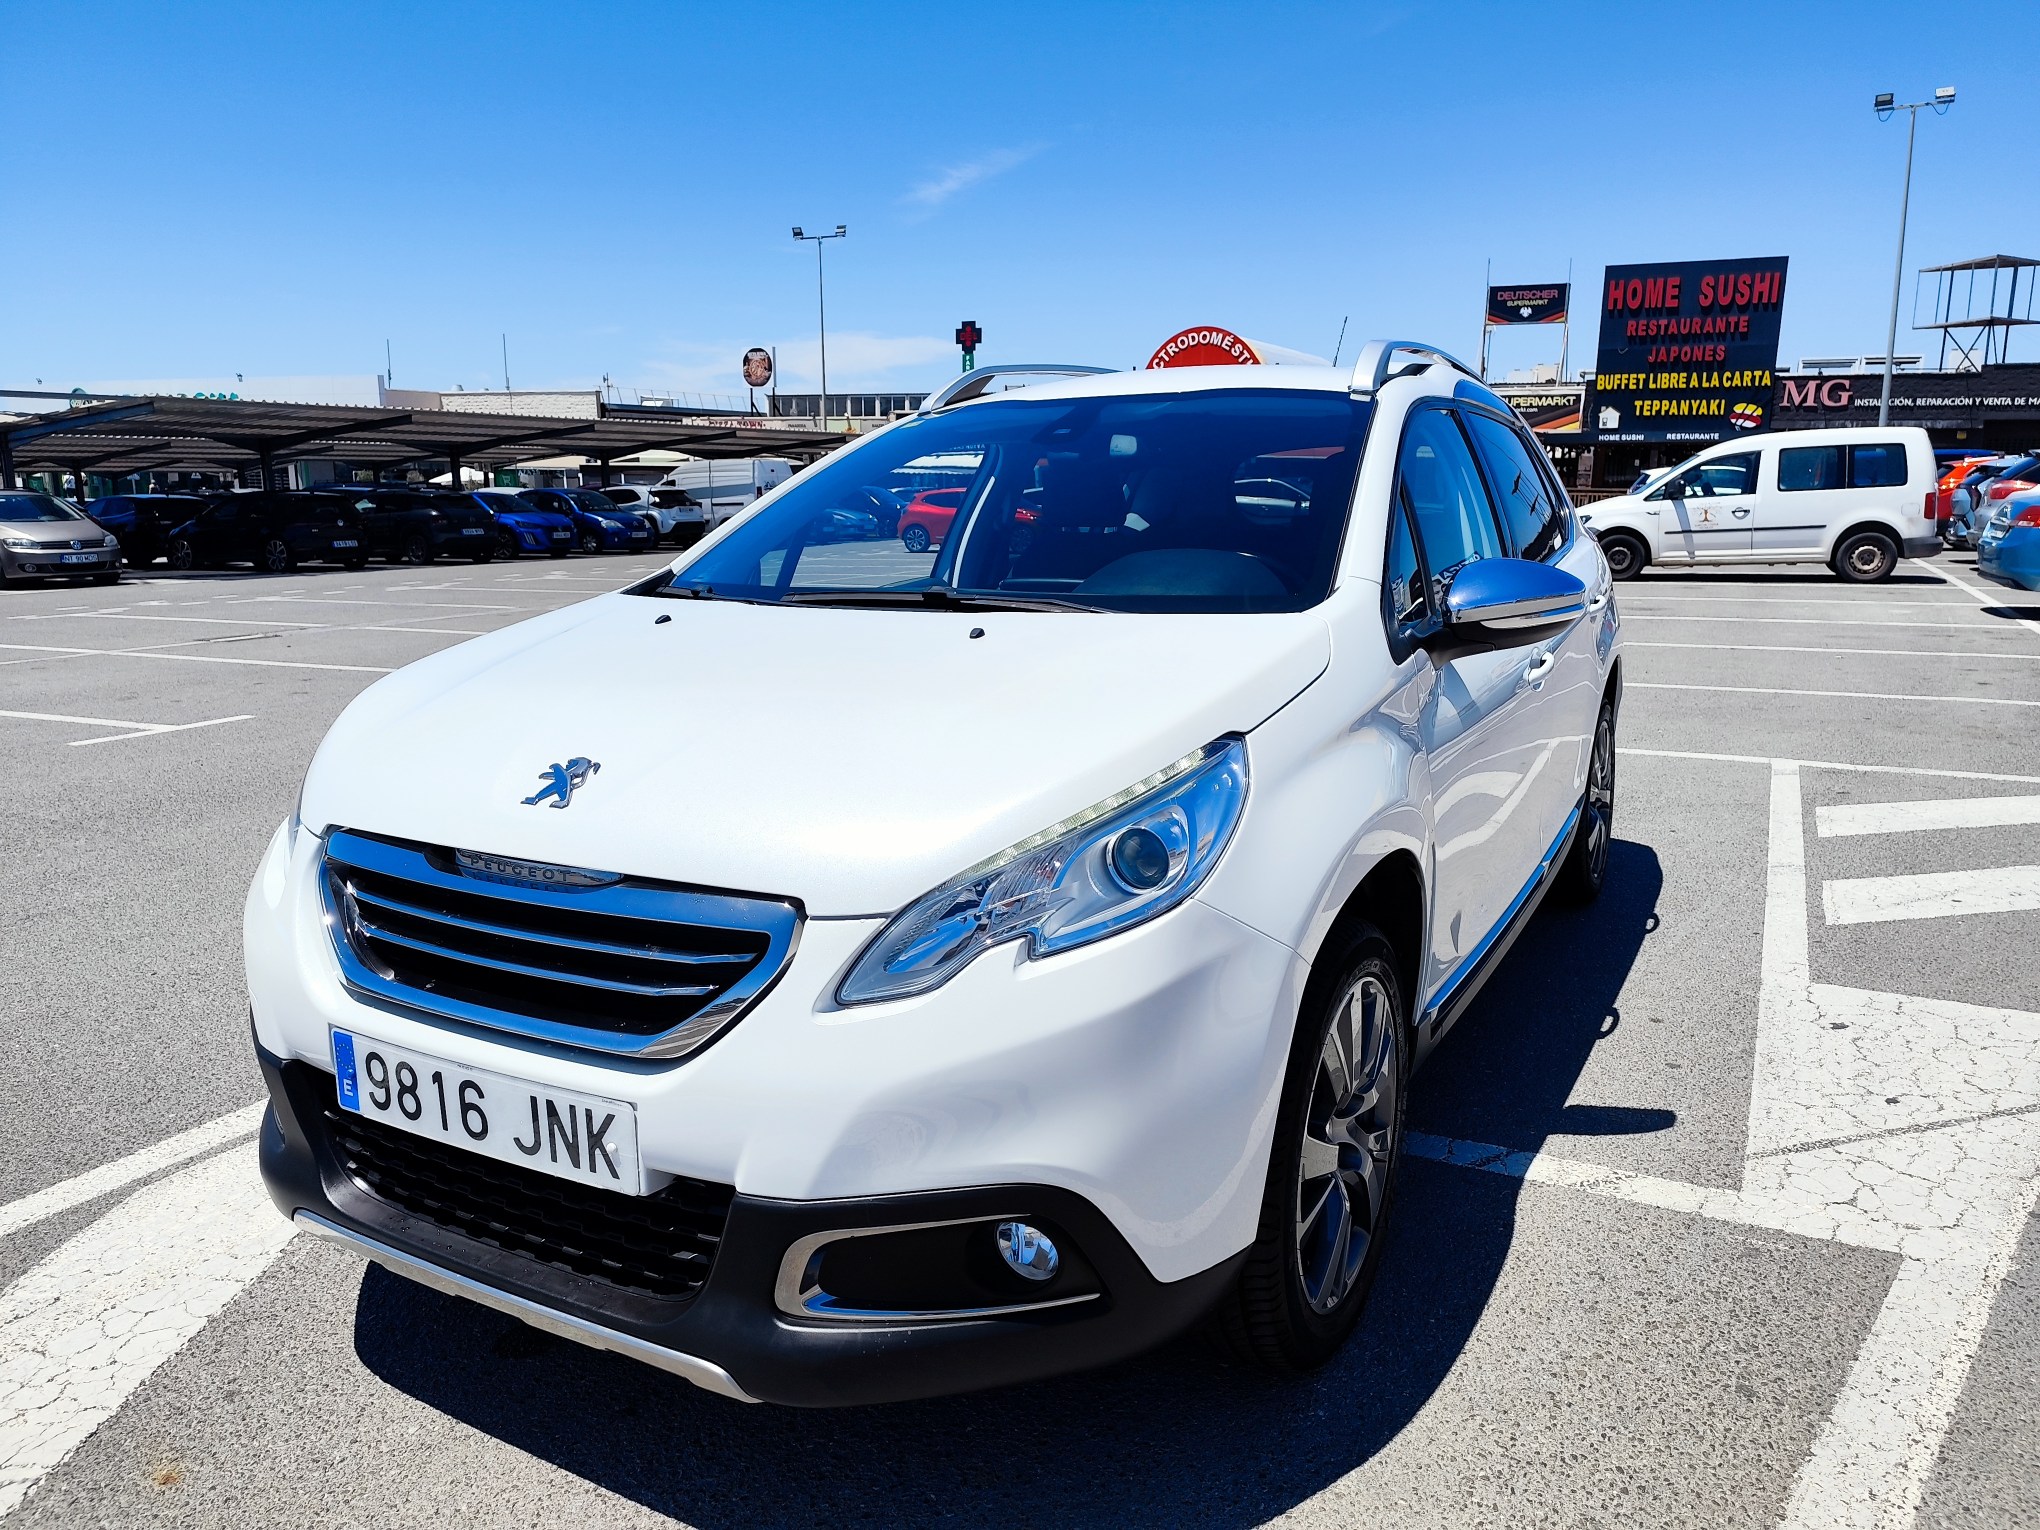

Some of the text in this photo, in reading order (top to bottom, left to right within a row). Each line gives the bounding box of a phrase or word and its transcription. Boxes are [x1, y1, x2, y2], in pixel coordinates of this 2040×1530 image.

[1497, 289, 1559, 301] DEUTSCHER
[1607, 271, 1782, 310] HOME SUSHI
[1506, 299, 1549, 307] SUPERMARKT
[1626, 315, 1750, 337] RESTAURANTE
[1647, 344, 1727, 363] JAPONES
[1596, 370, 1772, 391] BUFFET LIBRE A LA CARTA
[1502, 396, 1576, 407] UPERMARKT
[1778, 379, 1853, 408] MG
[1854, 396, 1914, 407] INSTALCIÓN,
[1915, 396, 1973, 406] REPARACIÓN
[1975, 397, 1983, 406] Y
[1983, 397, 2012, 406] VENTA
[2014, 397, 2026, 406] DE
[1634, 399, 1726, 416] TEPPANYAKI
[1621, 433, 1645, 441] SUSHI
[470, 854, 572, 882] PEUGEOT
[365, 1051, 621, 1180] 9816 JNK
